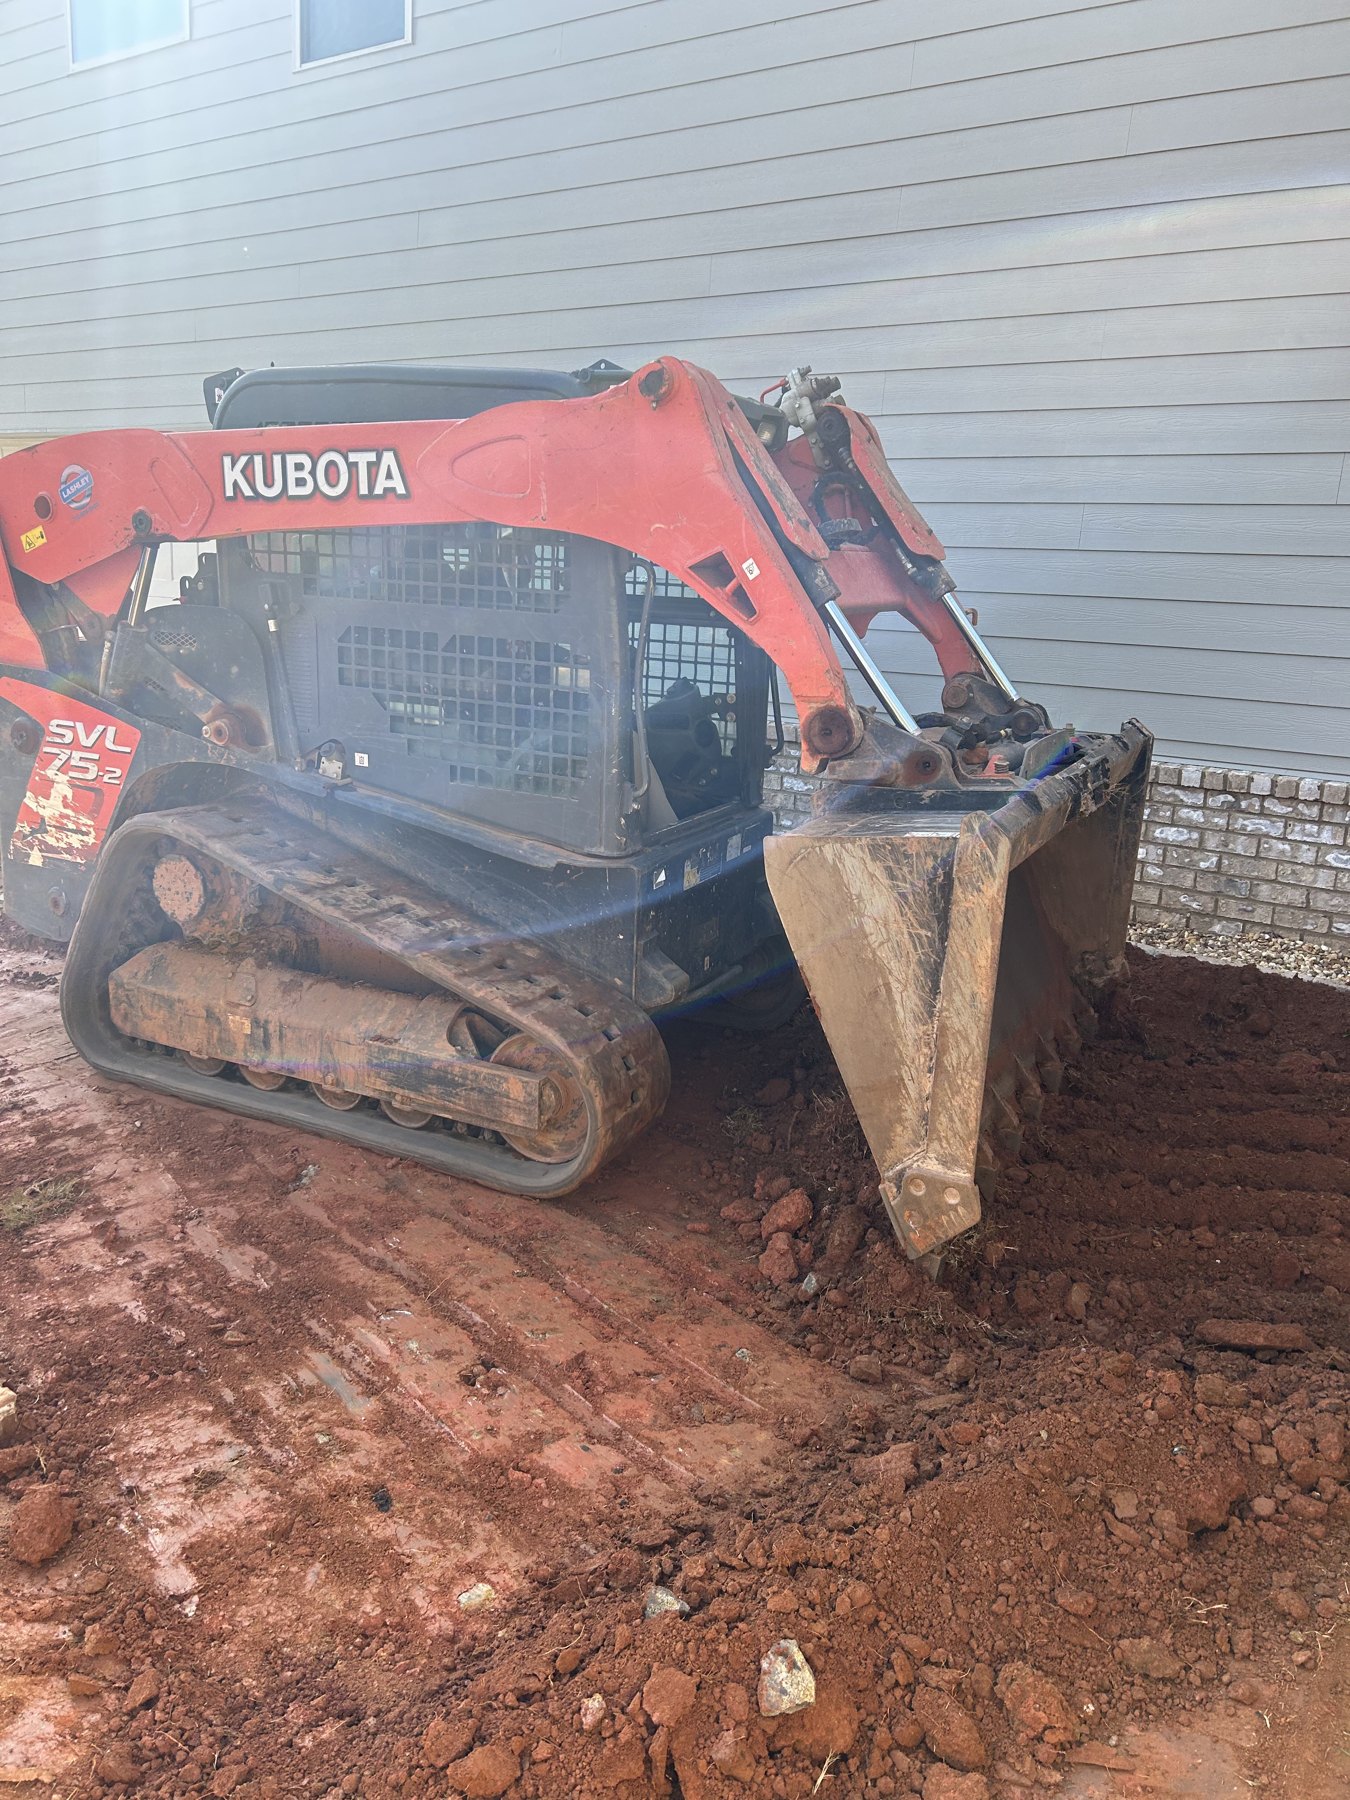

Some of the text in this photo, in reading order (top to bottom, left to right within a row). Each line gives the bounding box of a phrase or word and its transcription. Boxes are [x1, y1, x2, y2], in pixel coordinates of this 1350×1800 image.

[62, 474, 90, 499] LASHLEY
[222, 450, 407, 498] KUBOTA
[46, 719, 132, 754] SVL
[42, 747, 122, 785] 75-2
